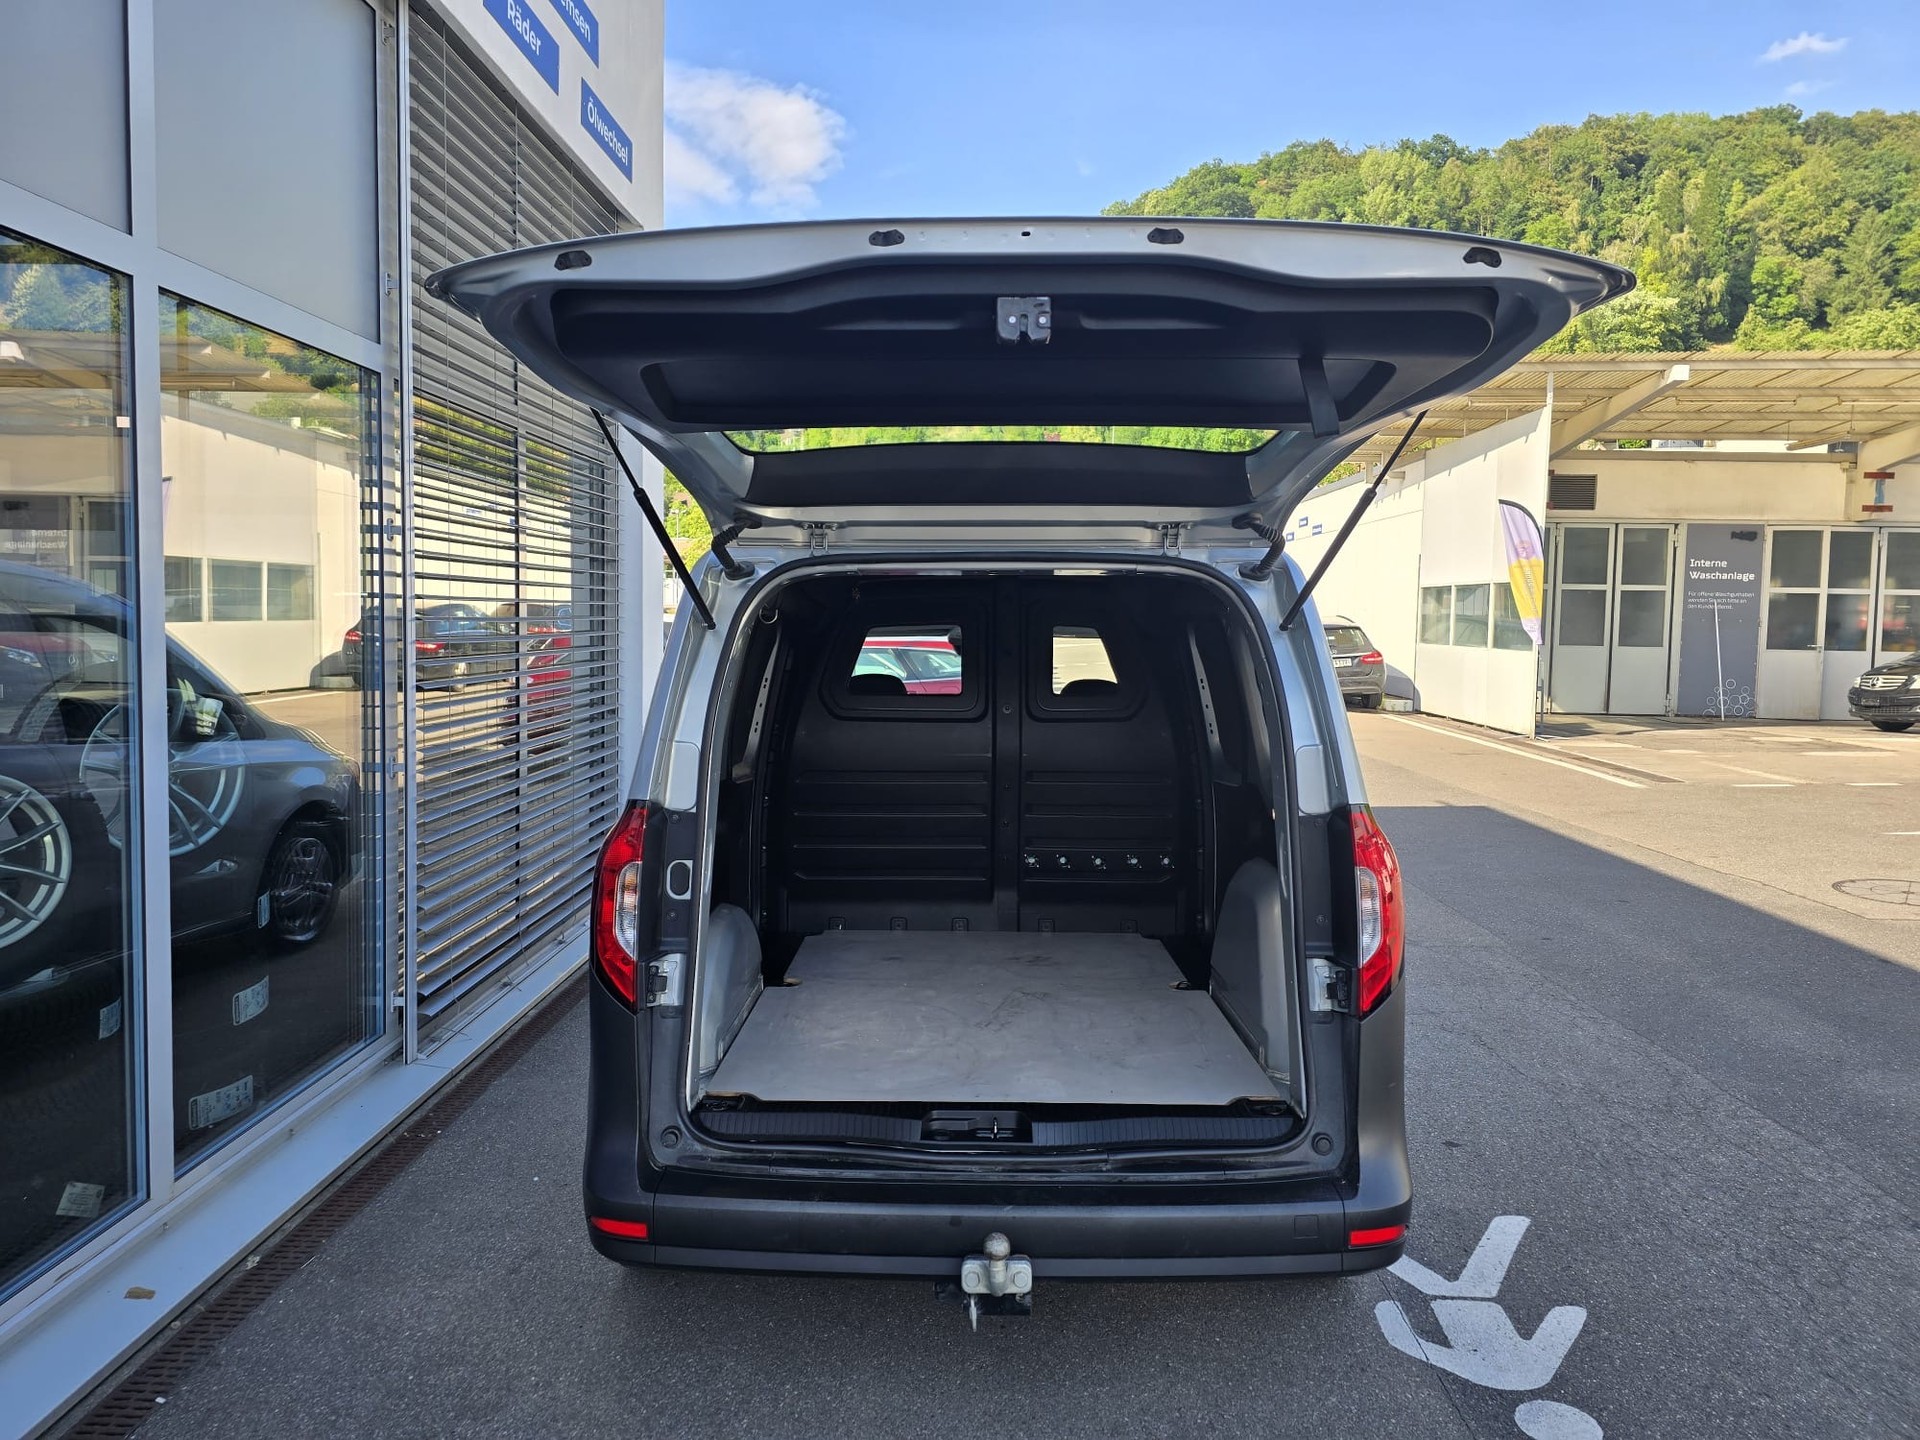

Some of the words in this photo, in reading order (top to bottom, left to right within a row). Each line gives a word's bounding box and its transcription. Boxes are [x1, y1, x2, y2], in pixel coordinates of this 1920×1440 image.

[507, 0, 542, 56] Räder
[587, 96, 628, 167] Ölwechsel
[1689, 558, 1728, 568] Interne
[1689, 570, 1756, 582] Waschanlage
